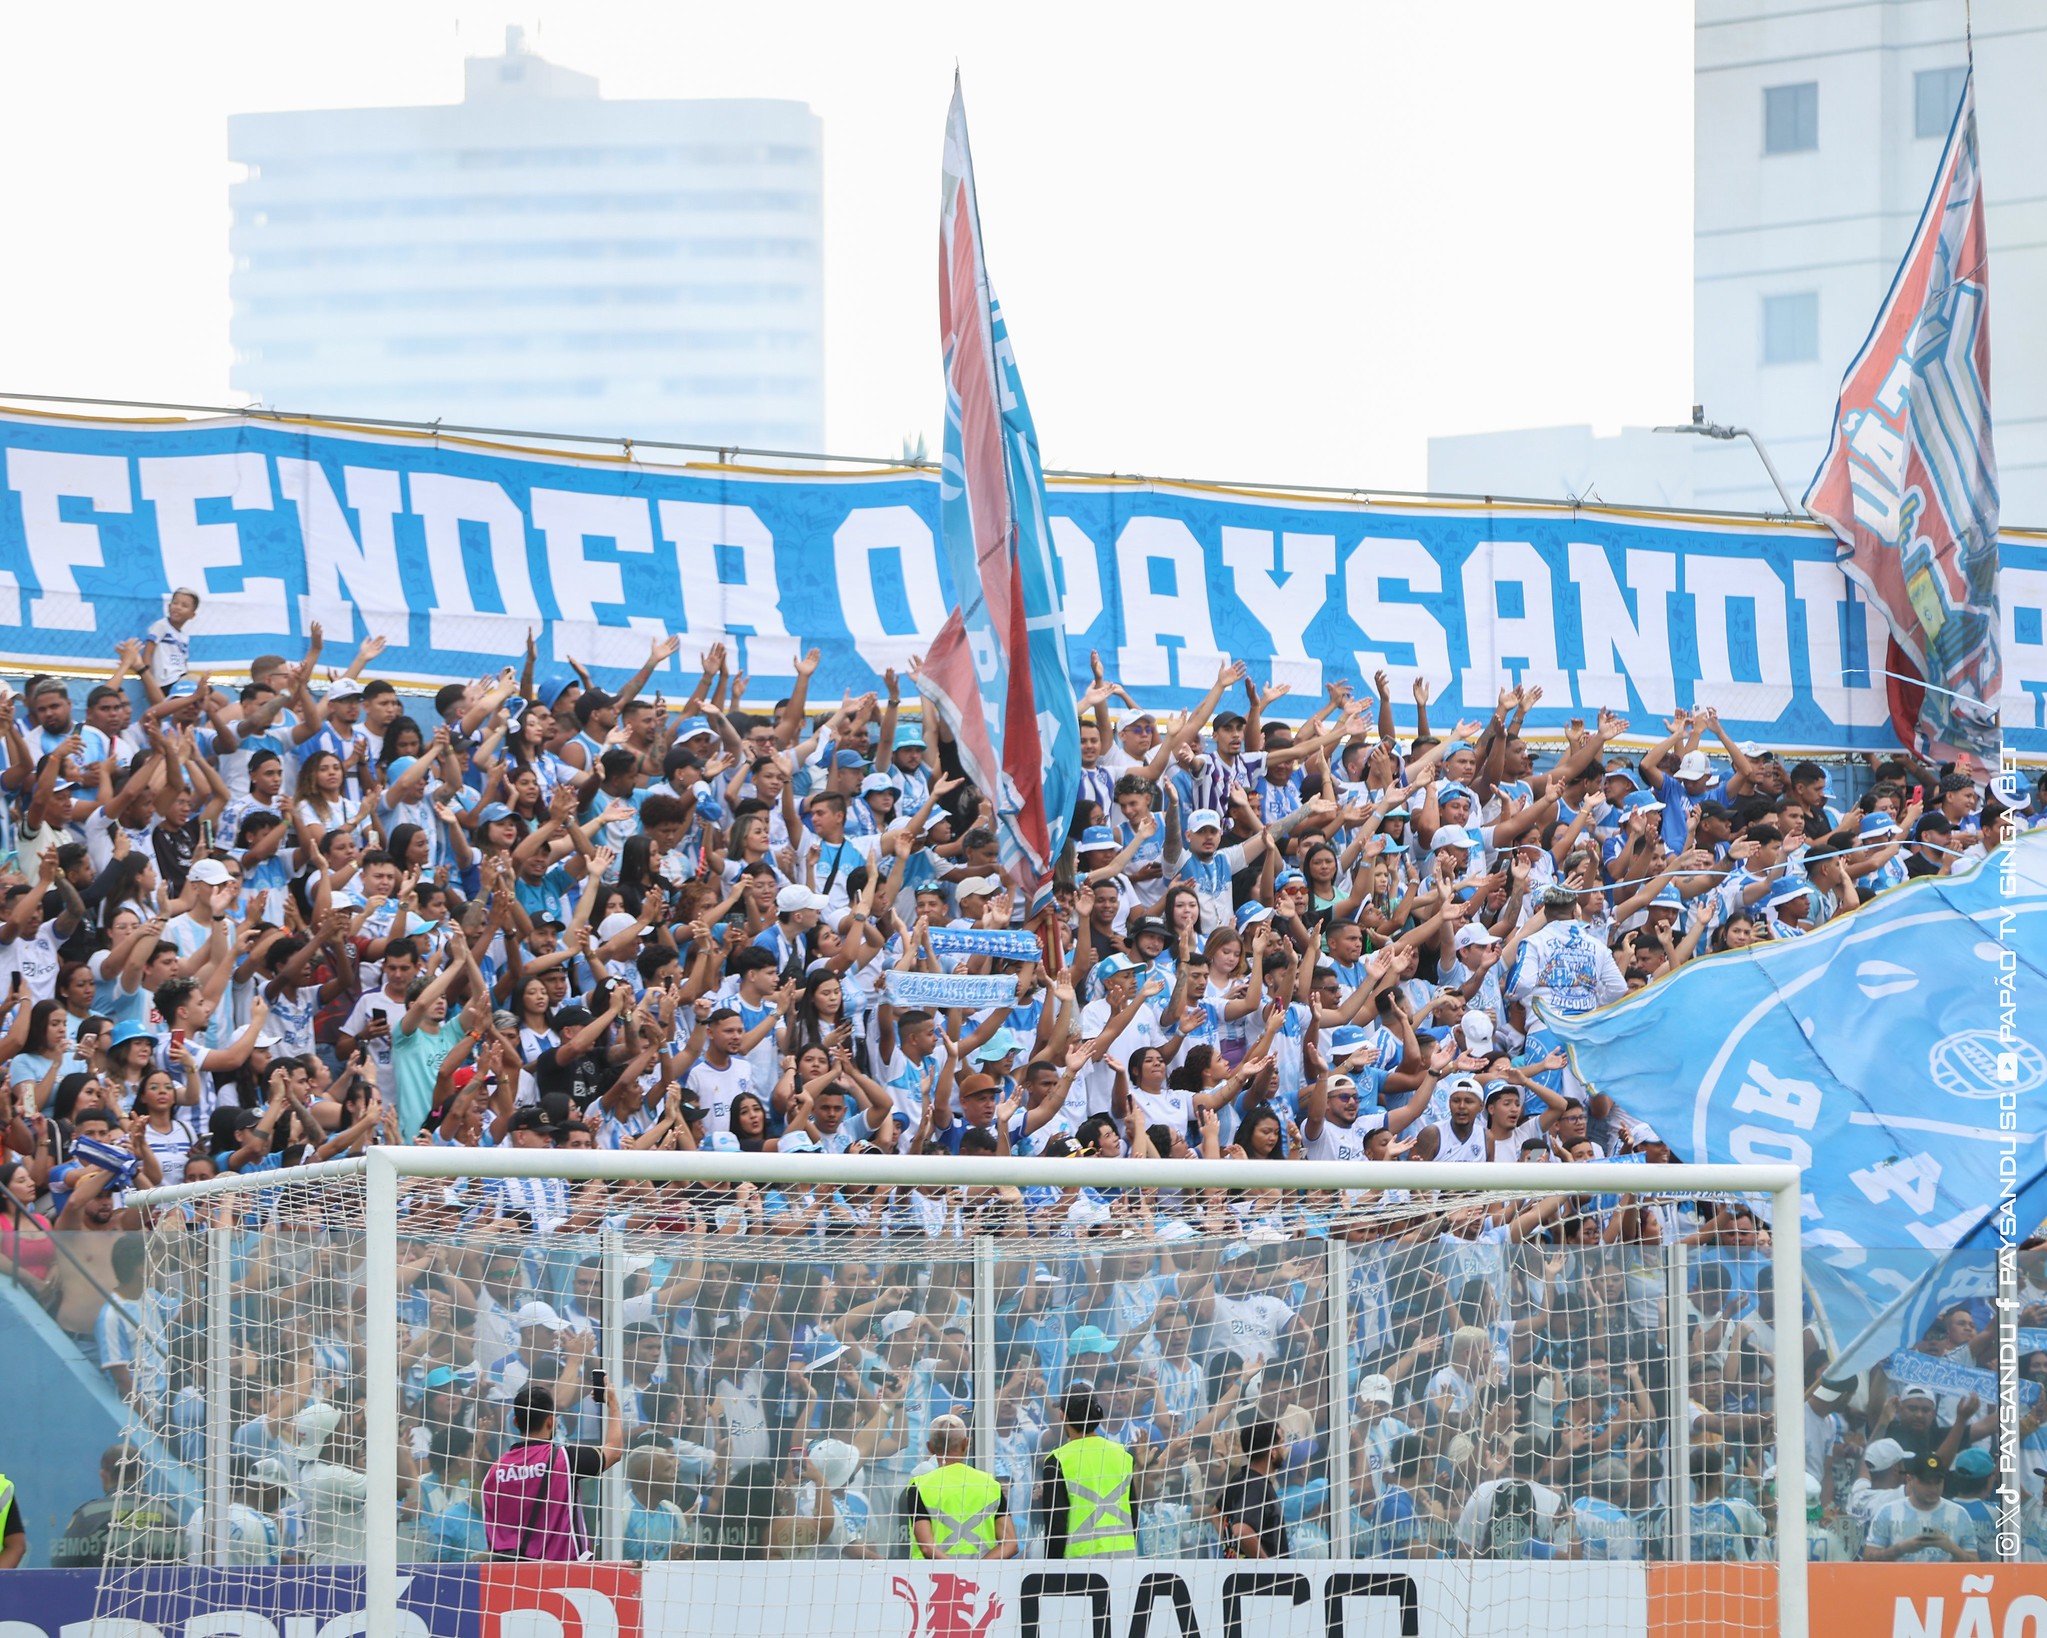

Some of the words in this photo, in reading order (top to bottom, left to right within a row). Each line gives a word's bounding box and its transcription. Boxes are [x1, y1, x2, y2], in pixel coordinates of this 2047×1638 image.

[0, 446, 802, 677] FENDER
[833, 505, 955, 677] O
[495, 1462, 547, 1483] RÁDIO
